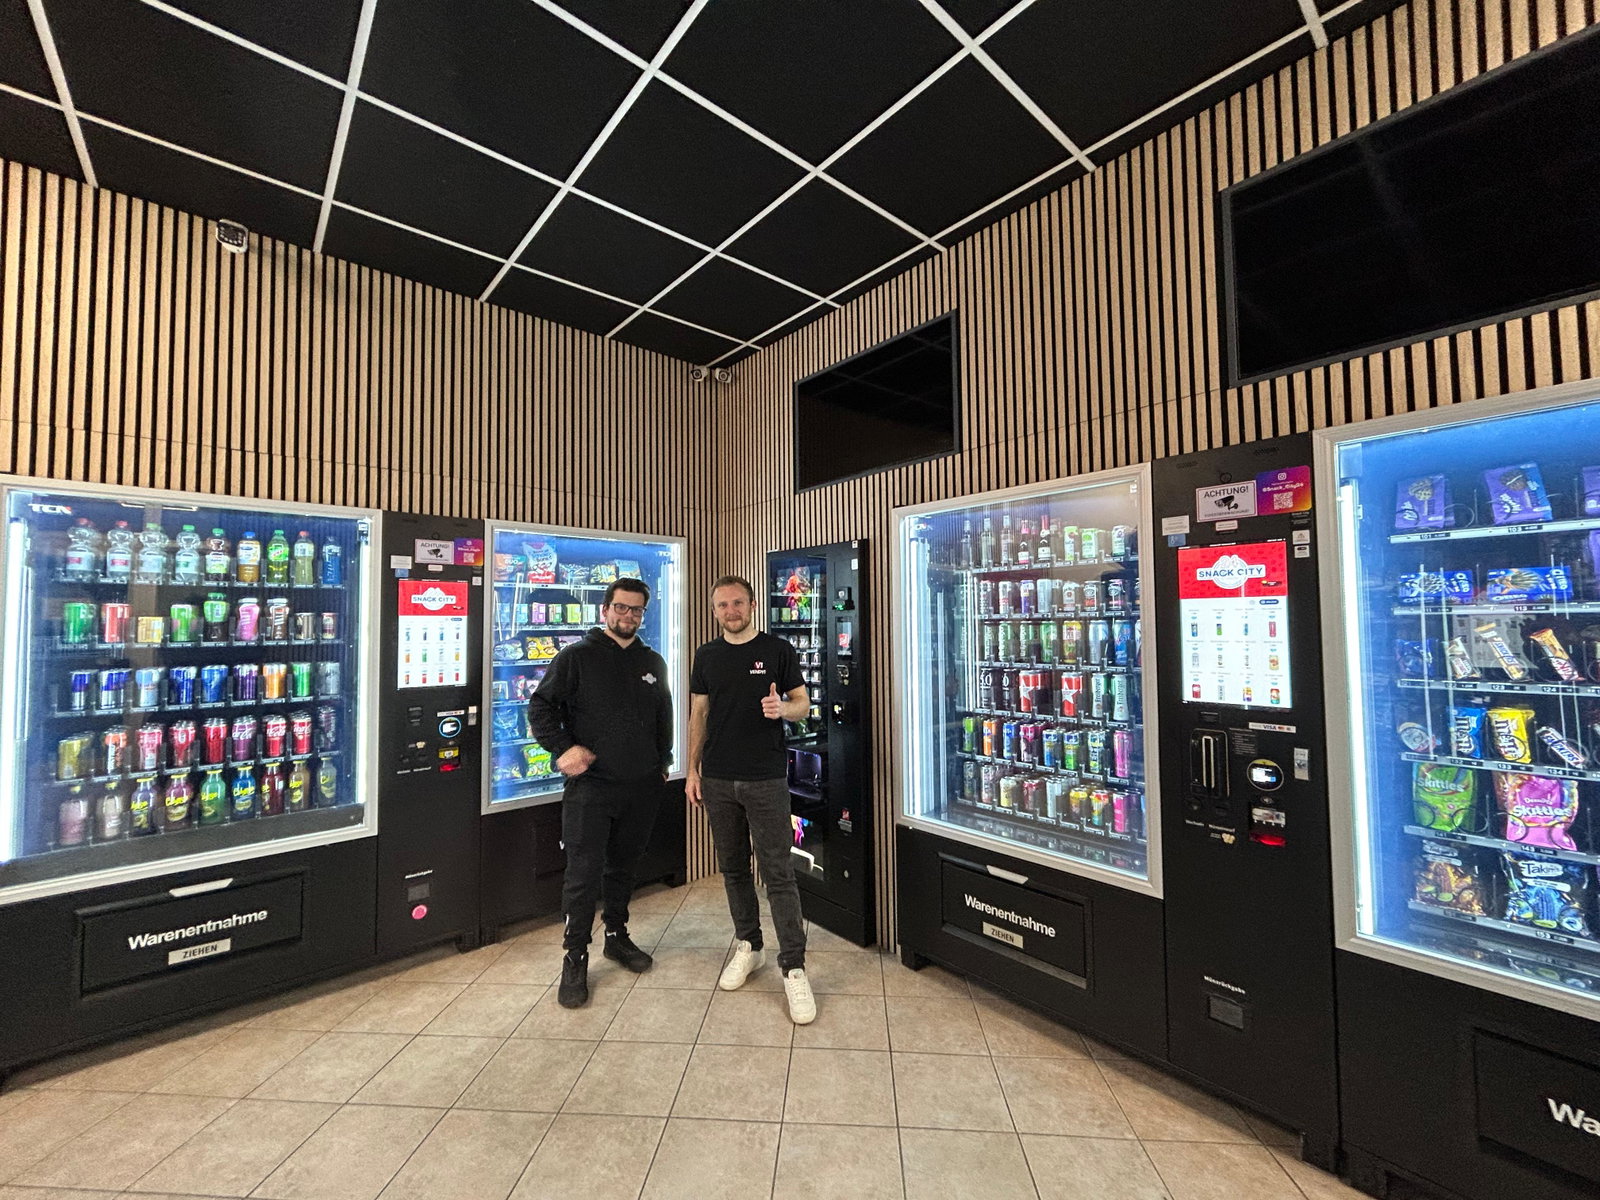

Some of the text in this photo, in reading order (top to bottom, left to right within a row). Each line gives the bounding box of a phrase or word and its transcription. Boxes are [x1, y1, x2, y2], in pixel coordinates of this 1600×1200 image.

[1204, 486, 1249, 498] ACHTUNG!
[1198, 567, 1263, 578] SNACK CITY
[1417, 777, 1465, 792] Skittles
[1513, 804, 1572, 817] Skittles
[964, 893, 1056, 937] Warenentnahme
[128, 910, 268, 950] Warenentnahme
[991, 927, 1015, 943] ZIEHEN
[182, 944, 218, 959] ZIEHEN
